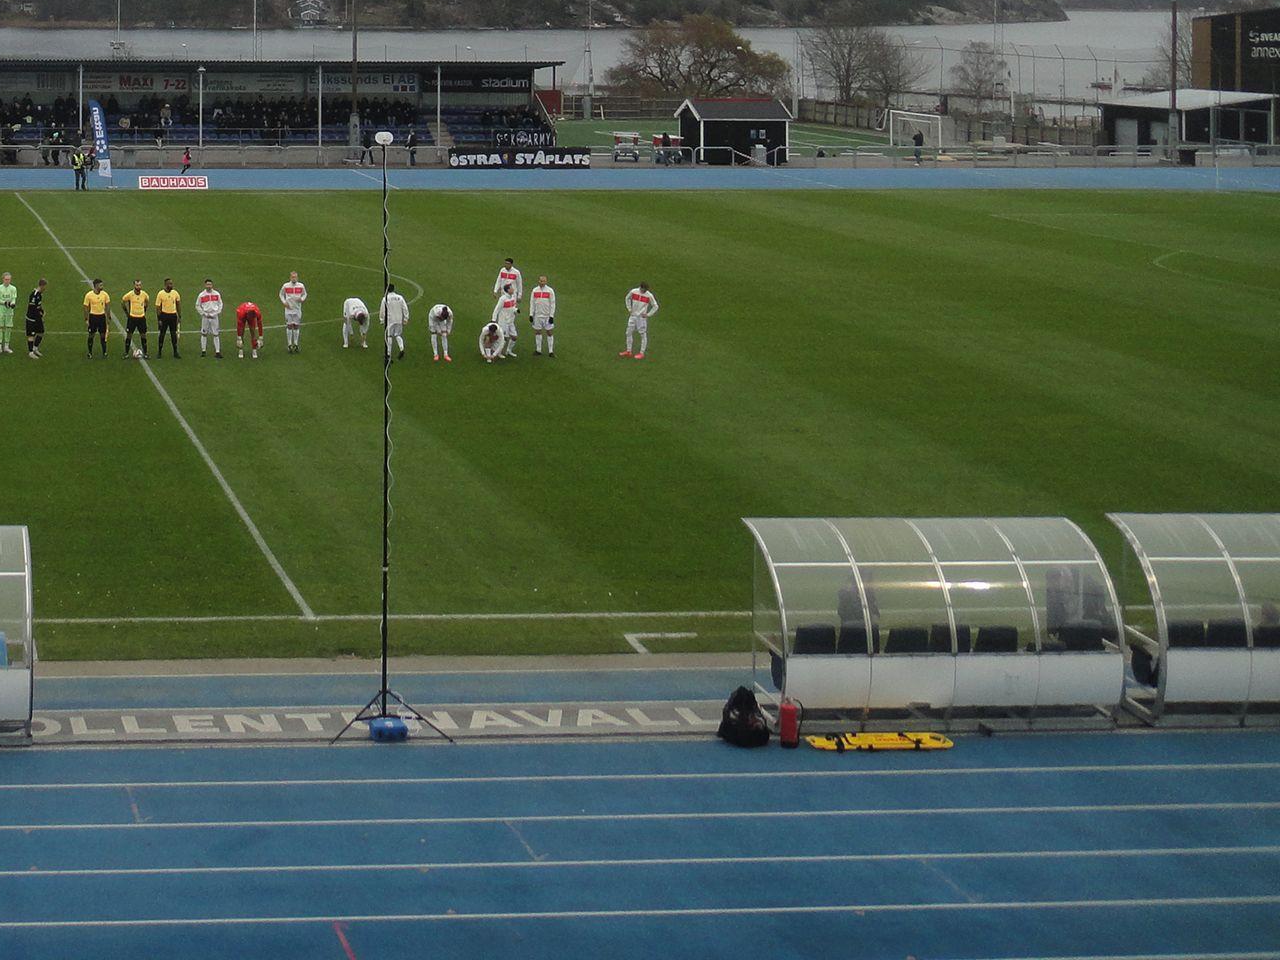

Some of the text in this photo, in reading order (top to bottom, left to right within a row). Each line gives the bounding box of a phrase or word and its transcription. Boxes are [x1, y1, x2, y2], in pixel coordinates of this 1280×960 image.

[119, 74, 154, 87] MAXI
[164, 78, 186, 90] 7-22
[399, 74, 416, 84] AB
[481, 77, 529, 88] stadium
[527, 132, 552, 146] ARMY
[450, 149, 591, 167] ÖSTRA STÅPLATS
[140, 177, 206, 187] BAUHAUS
